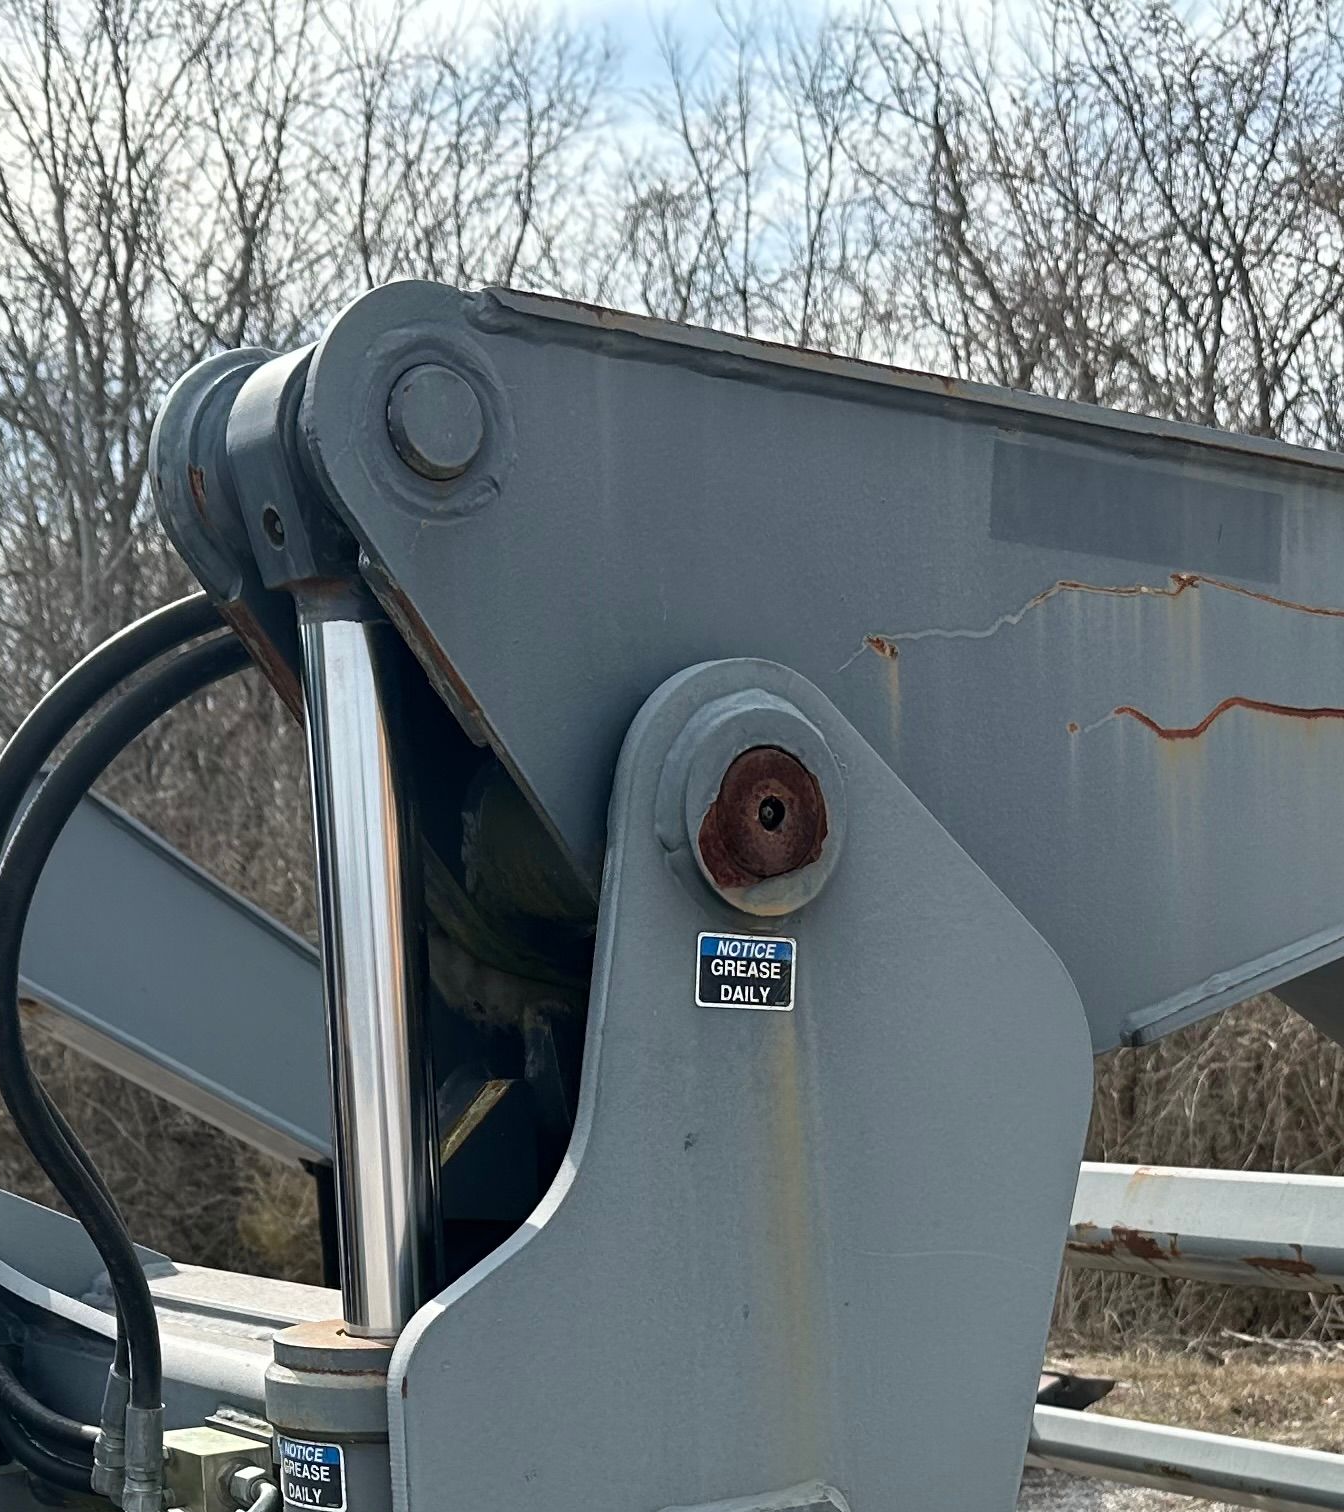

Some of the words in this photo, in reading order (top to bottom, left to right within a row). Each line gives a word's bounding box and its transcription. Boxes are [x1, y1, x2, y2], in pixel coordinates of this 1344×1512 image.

[716, 940, 777, 959] NOTICE
[710, 958, 781, 979] GREASE
[720, 984, 771, 1003] DAILY
[284, 1441, 324, 1463] NOTICE
[283, 1457, 331, 1482] GREASE
[288, 1482, 322, 1504] DAILY
